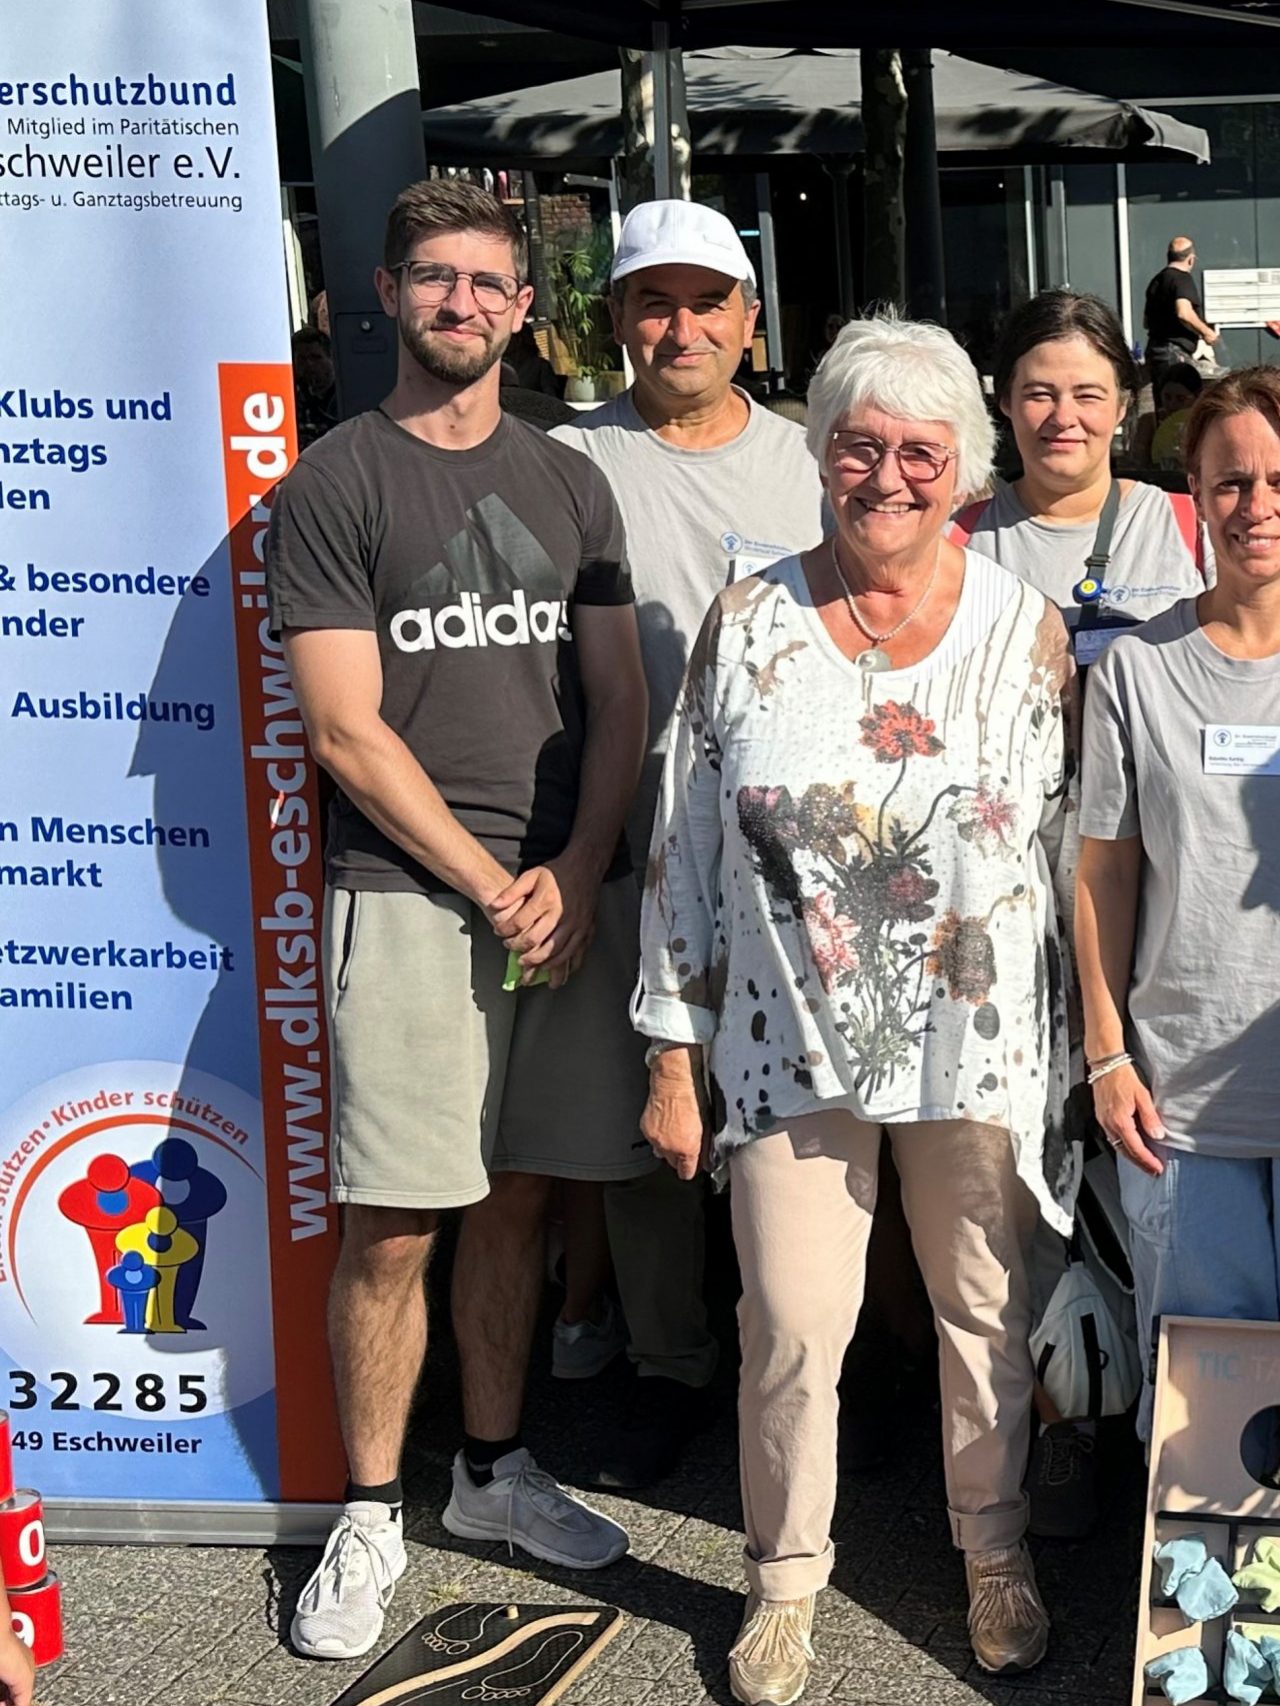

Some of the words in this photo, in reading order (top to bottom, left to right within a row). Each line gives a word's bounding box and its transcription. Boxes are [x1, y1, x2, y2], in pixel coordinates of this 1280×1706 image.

[0, 73, 237, 106] erschutzbund
[7, 117, 86, 139] Mitglied
[92, 118, 114, 135] im
[120, 117, 239, 136] Paritätischen
[173, 146, 241, 179] e.V.
[51, 194, 67, 208] u.
[73, 190, 243, 212] Ganztagsbetreuung
[0, 388, 94, 420] Klubs
[105, 391, 172, 421] und
[0, 481, 50, 511] en
[27, 563, 211, 597] besondere
[2, 608, 85, 638] nder
[11, 690, 215, 731] Ausbildung
[31, 816, 210, 848] Menschen
[231, 391, 328, 1242] www.dksb-eschwilrde
[0, 859, 102, 887] markt
[0, 939, 235, 972] tzwerkarbeit
[0, 981, 132, 1010] amilien
[50, 1090, 134, 1127] Kinder
[143, 1090, 250, 1145] schützen
[1195, 1350, 1240, 1382] TIC
[11, 1430, 43, 1451] 49
[53, 1430, 202, 1454] Eschweiler
